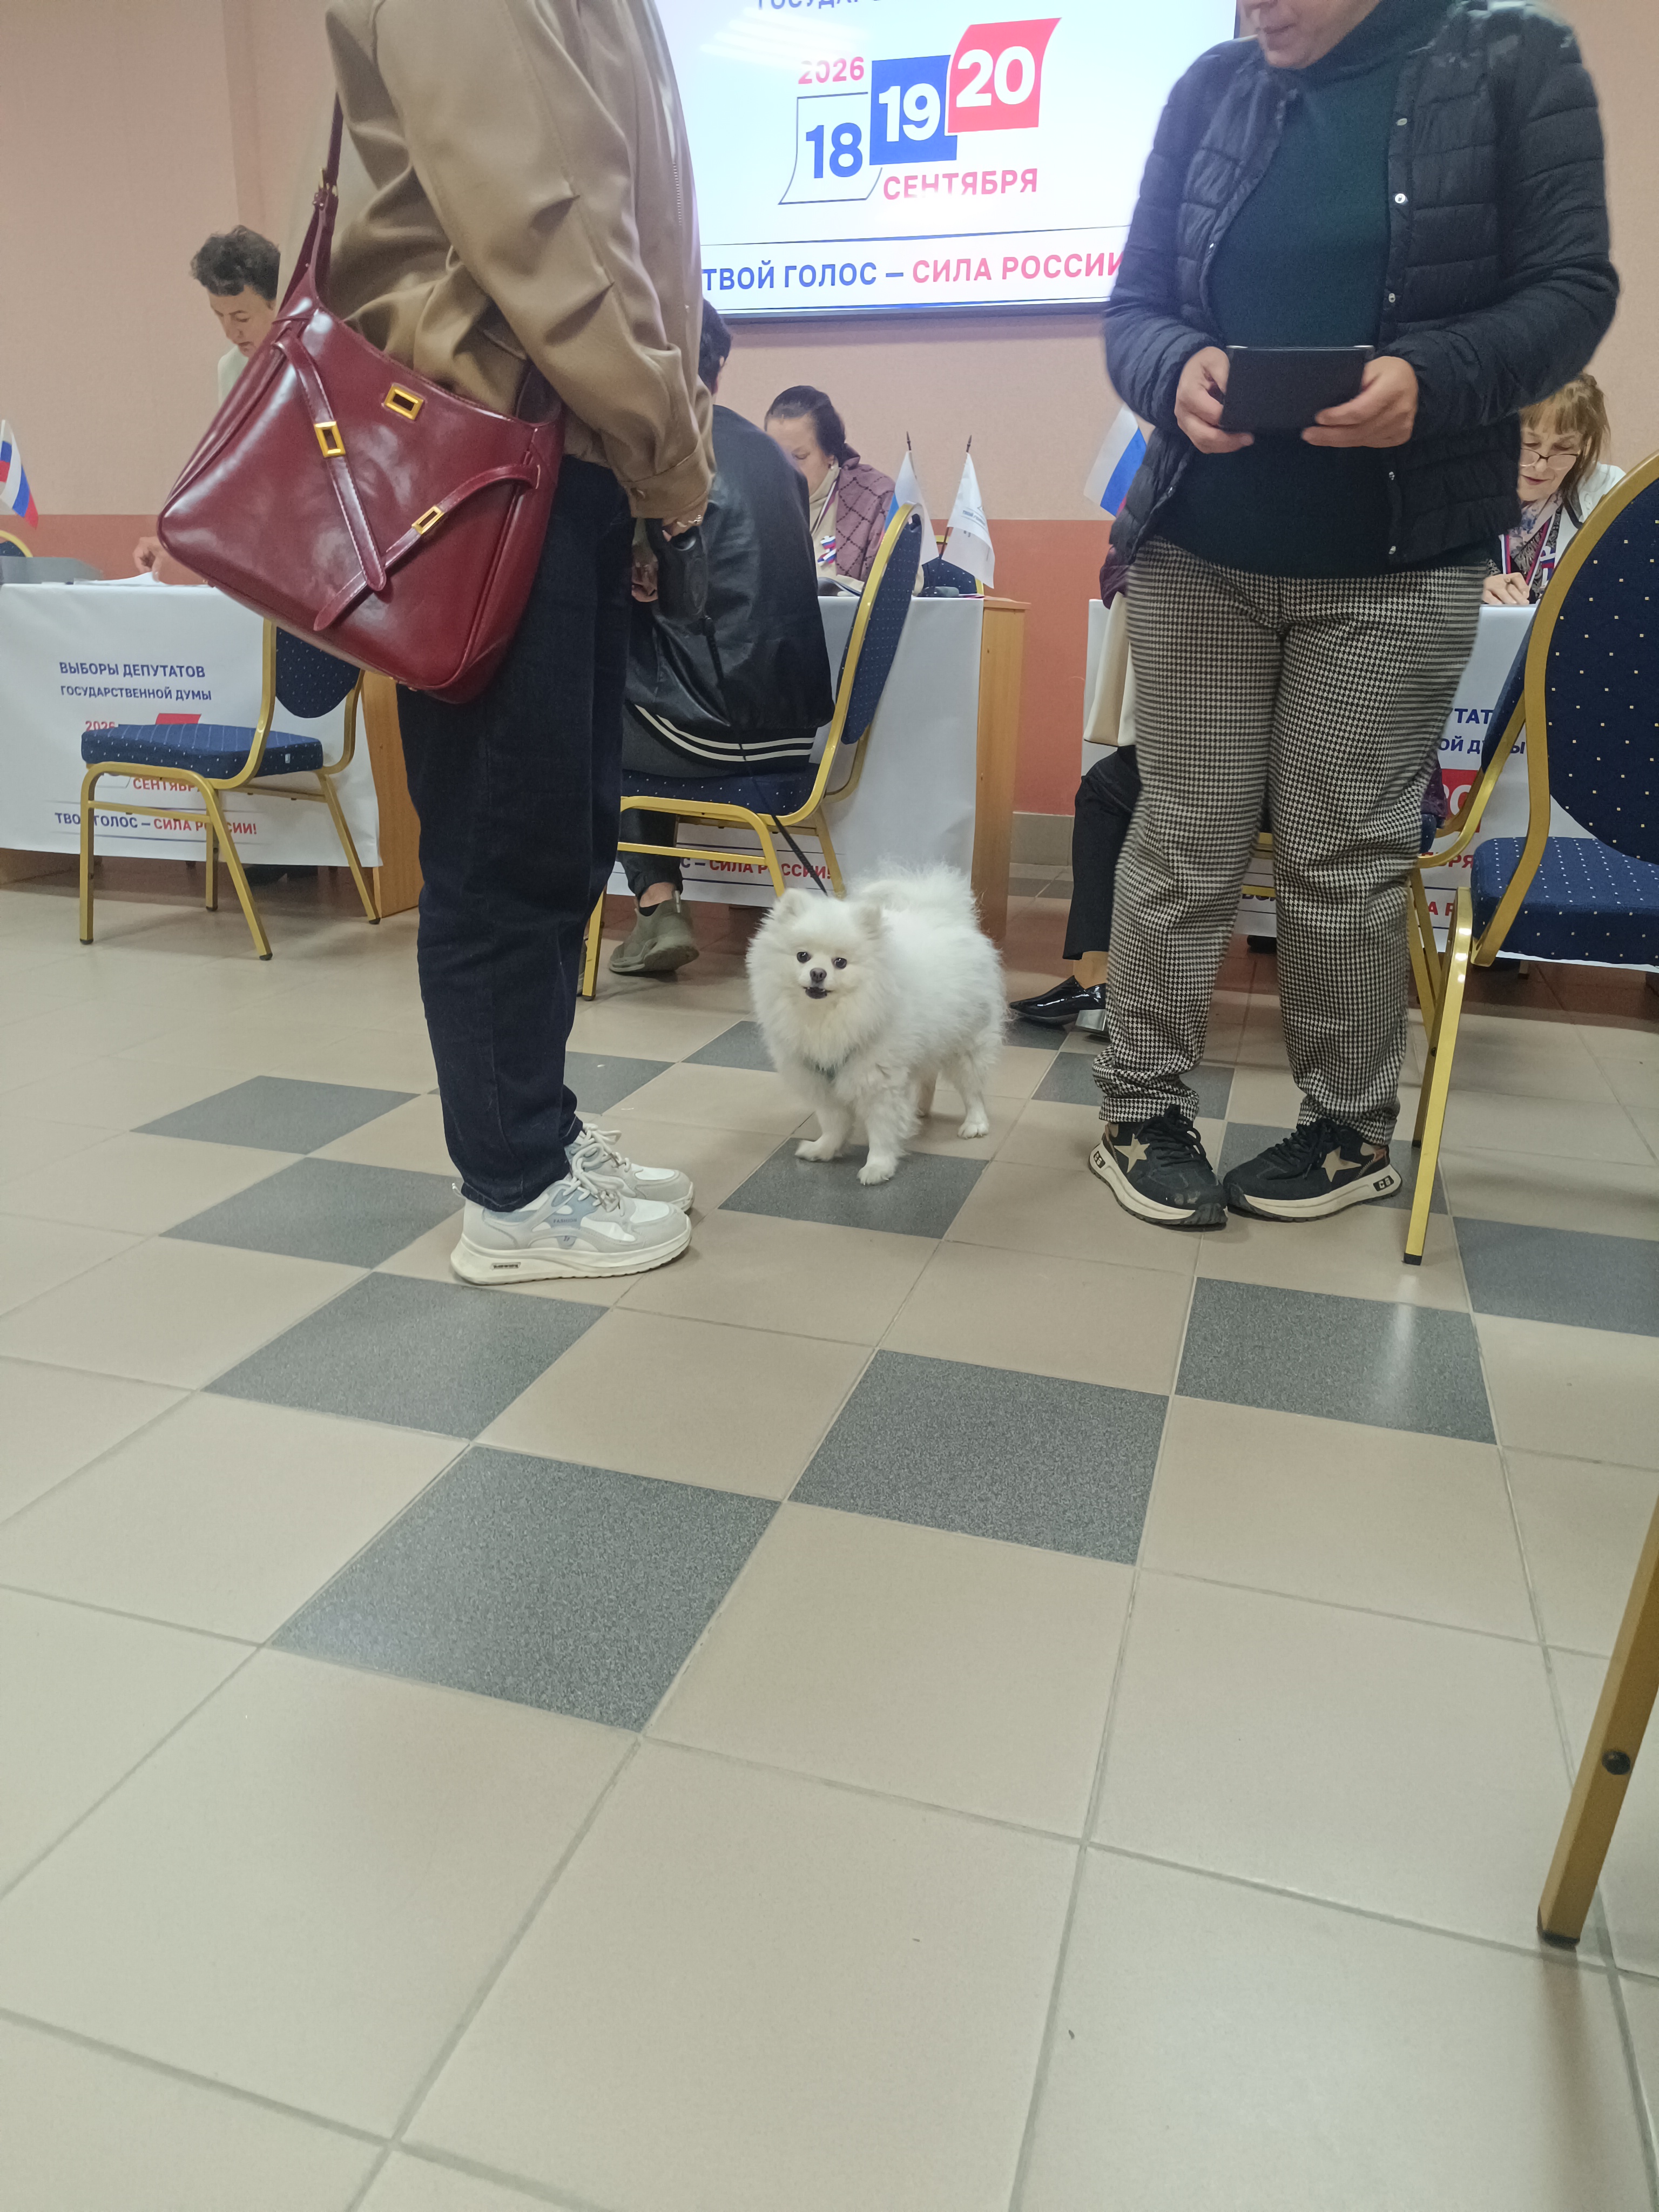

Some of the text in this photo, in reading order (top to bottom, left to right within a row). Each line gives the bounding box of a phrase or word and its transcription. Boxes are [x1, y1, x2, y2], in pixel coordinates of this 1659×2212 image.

[798, 56, 864, 84] 2026
[806, 46, 1035, 179] 18 19 20
[883, 168, 1037, 200] СЕНТЯБРЯ
[702, 260, 774, 291] ТВОЙ
[785, 262, 876, 287] ГОЛОС
[913, 258, 992, 283] СИЛА
[59, 662, 206, 678] ВЫБОРЫ ДЕПУТАТОВ
[60, 685, 212, 701] ГОСУДАРСТВЕННОЙ ДУМЫ
[55, 812, 81, 825] ТВО
[94, 815, 138, 828] ГОЛОС
[153, 818, 191, 831] СИЛА
[709, 859, 753, 873] СИЛА
